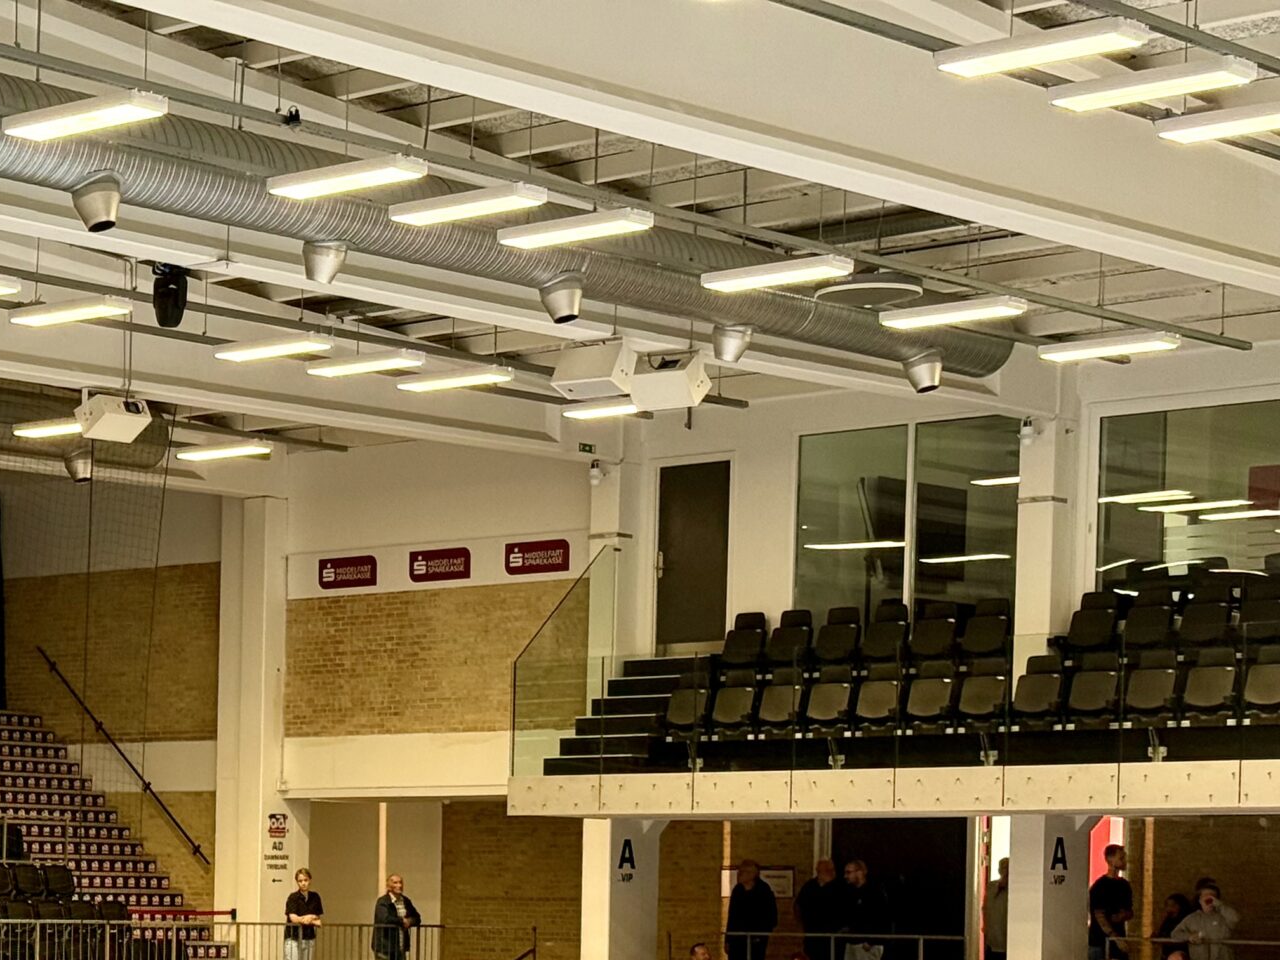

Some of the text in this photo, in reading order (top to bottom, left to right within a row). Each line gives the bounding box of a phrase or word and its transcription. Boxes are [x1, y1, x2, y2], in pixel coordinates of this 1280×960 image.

[524, 549, 564, 559] MIDDELFART
[524, 556, 563, 565] SPAREKASSE
[617, 838, 636, 870] A
[1050, 837, 1068, 871] A
[1053, 875, 1065, 885] VIP
